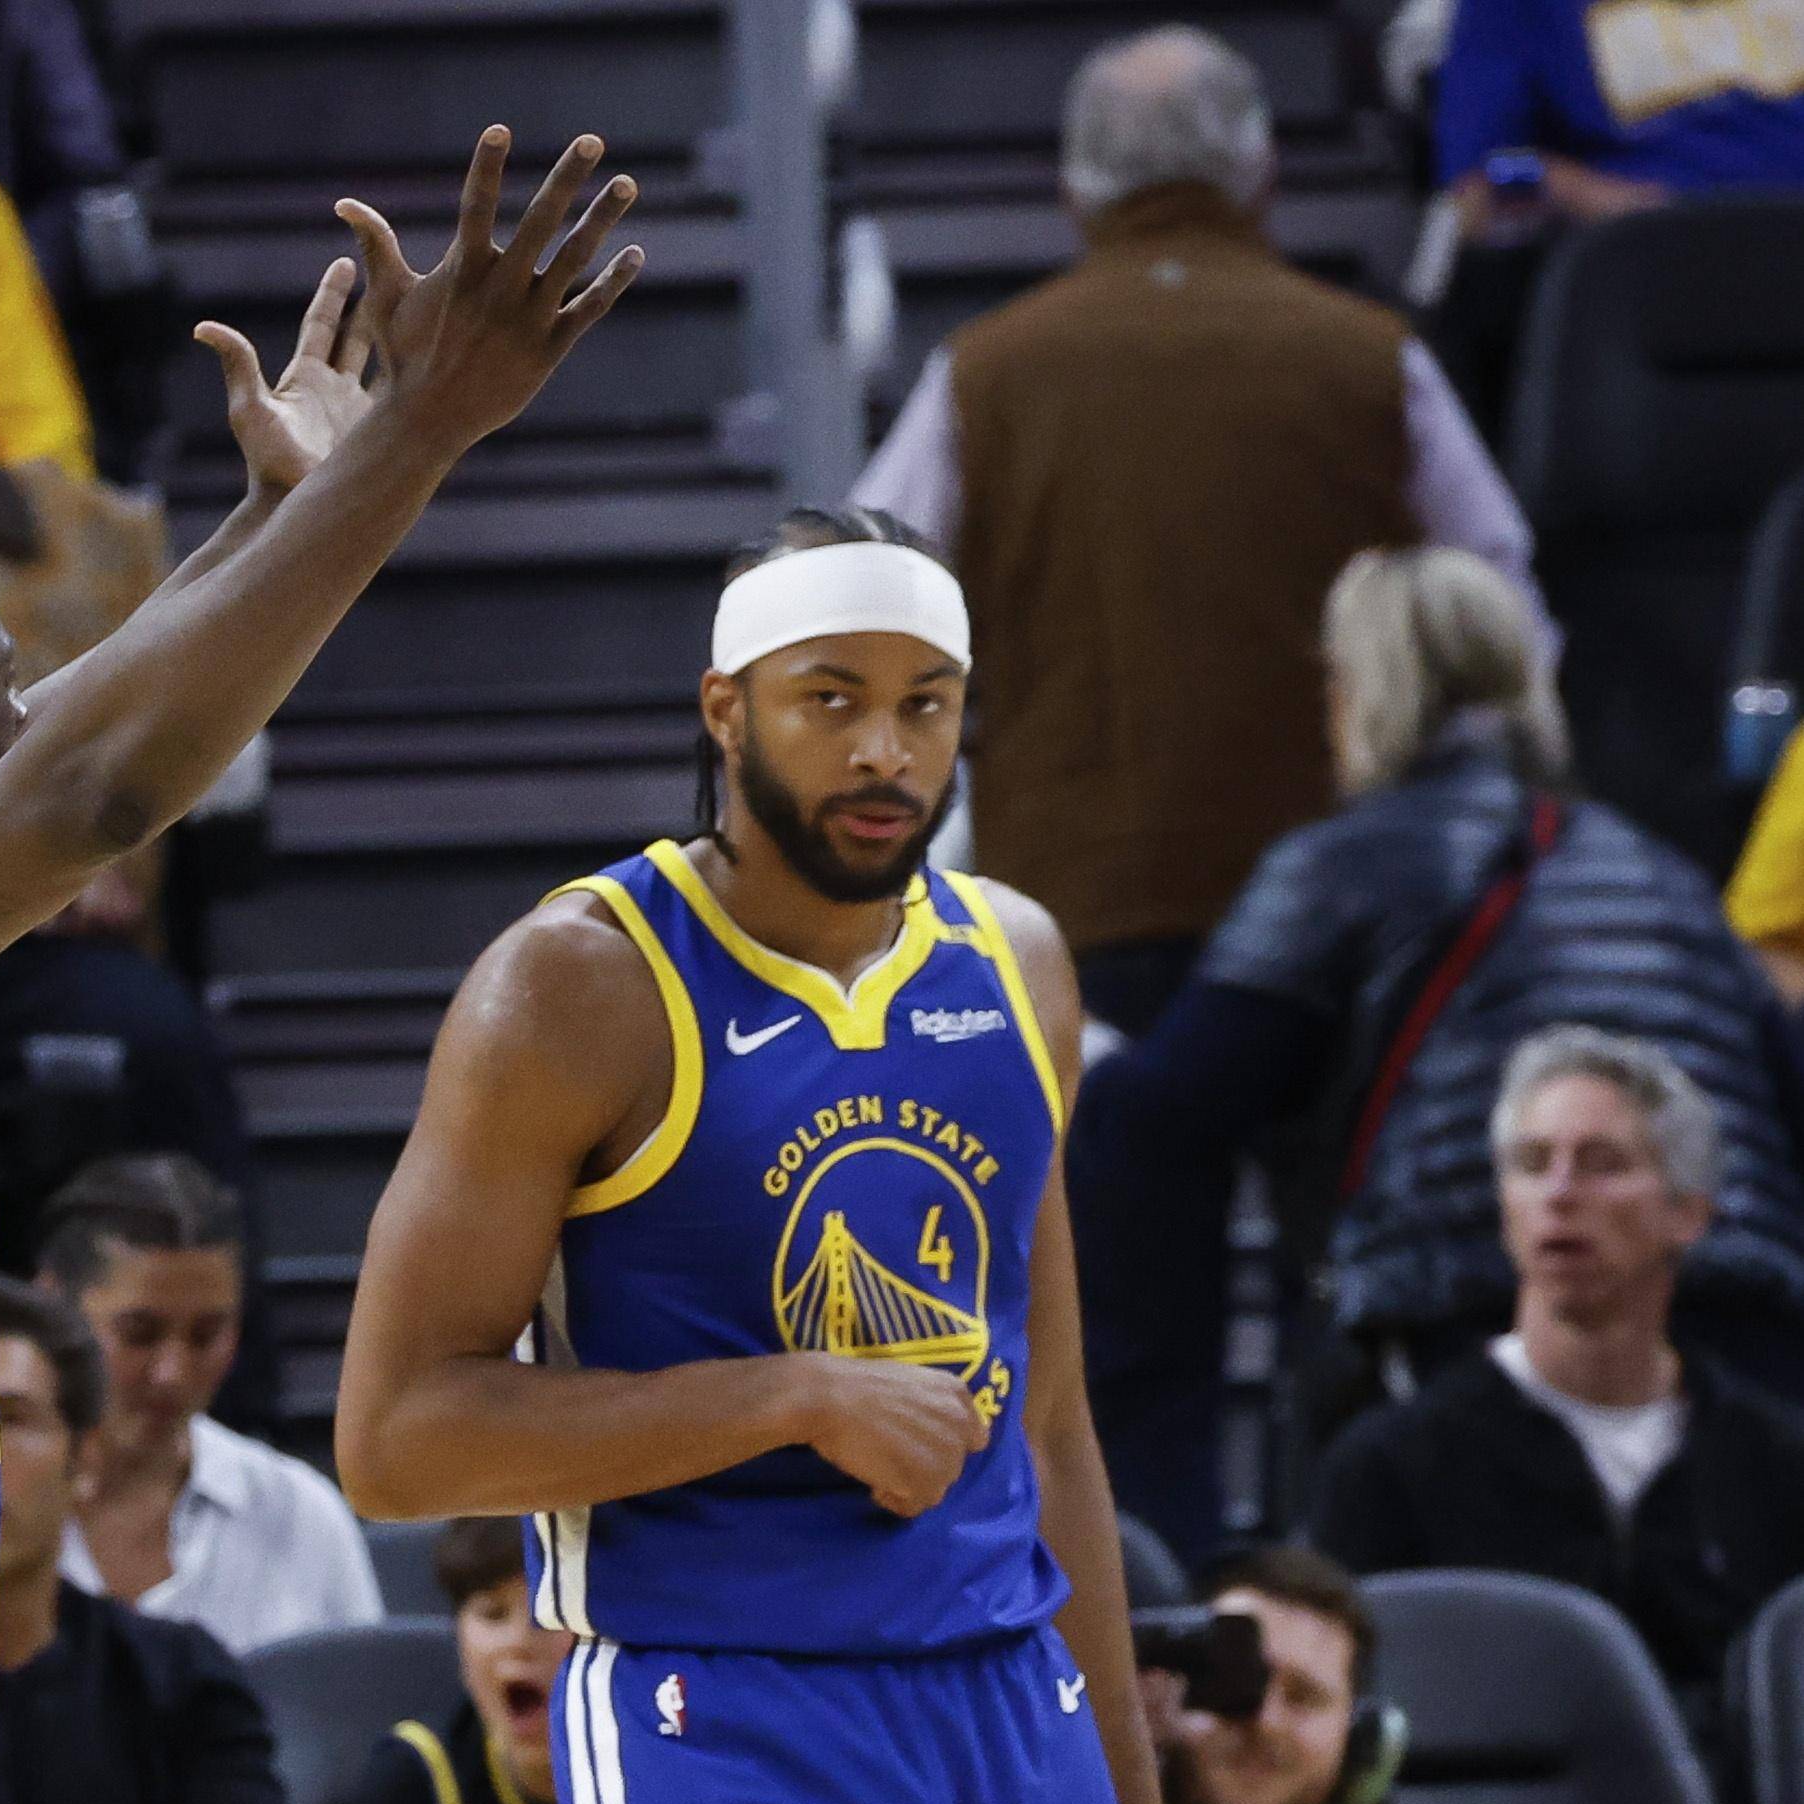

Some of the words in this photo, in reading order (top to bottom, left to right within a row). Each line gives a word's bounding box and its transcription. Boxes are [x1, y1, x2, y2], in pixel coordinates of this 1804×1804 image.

[762, 1094, 884, 1198] GOLDEN
[898, 1098, 1001, 1187] STATE
[917, 1204, 956, 1284] 4
